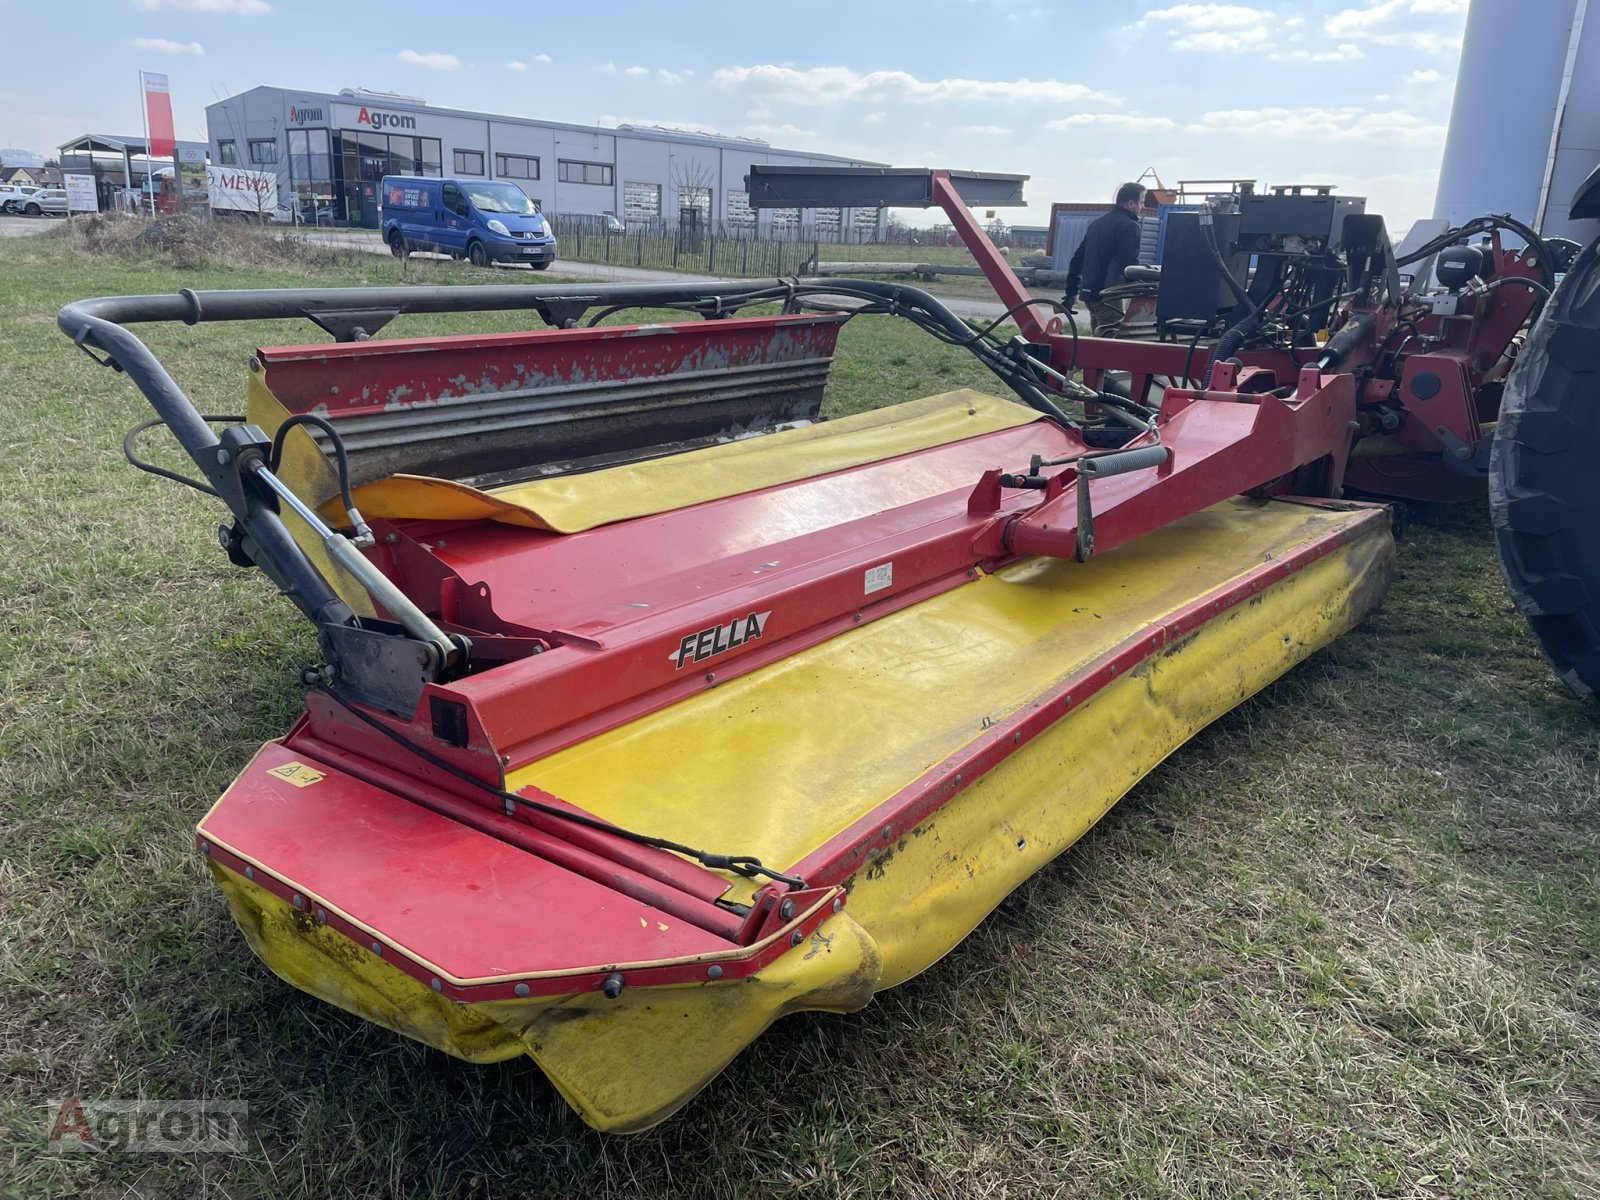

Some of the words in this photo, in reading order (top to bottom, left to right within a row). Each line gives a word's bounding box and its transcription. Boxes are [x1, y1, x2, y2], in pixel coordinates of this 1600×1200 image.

[290, 106, 323, 126] Agrom
[358, 106, 416, 129] Agrom
[220, 174, 270, 193] MEWA
[675, 612, 763, 670] FELLA
